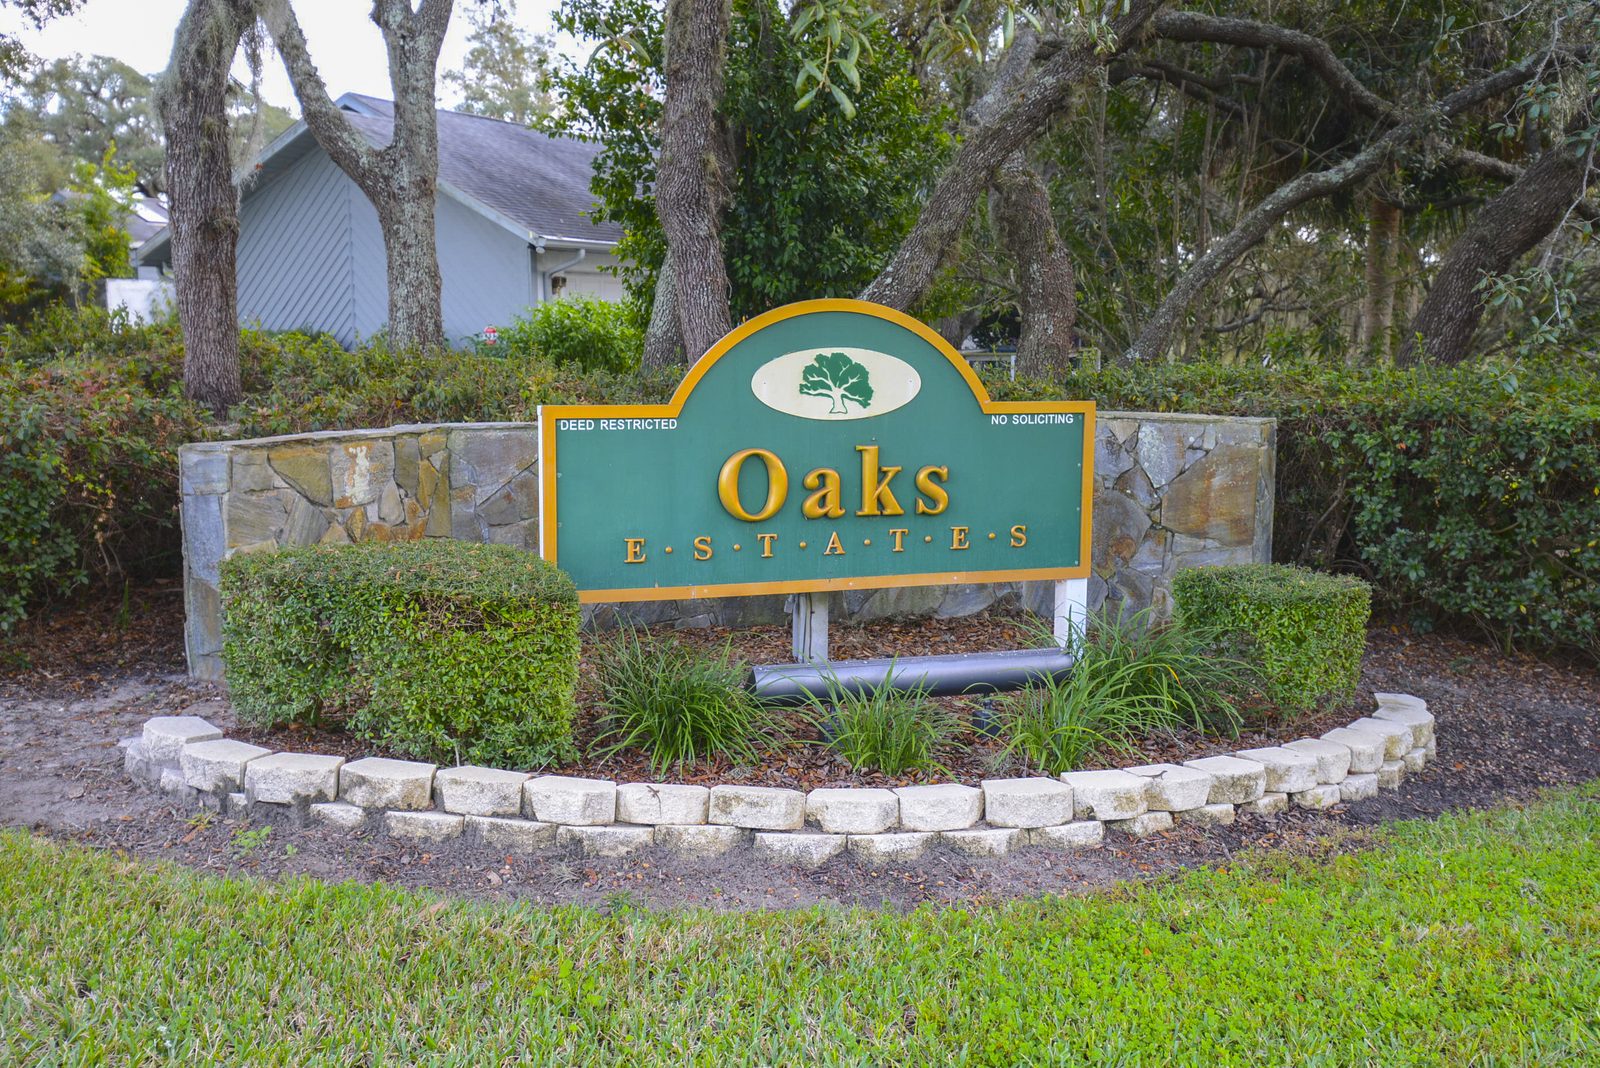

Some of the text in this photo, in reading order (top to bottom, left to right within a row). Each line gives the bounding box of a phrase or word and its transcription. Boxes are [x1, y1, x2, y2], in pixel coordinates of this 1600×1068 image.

[560, 418, 678, 431] DEED RESTRICTED
[991, 413, 1074, 425] NO SOLICITING
[717, 445, 950, 522] Oaks
